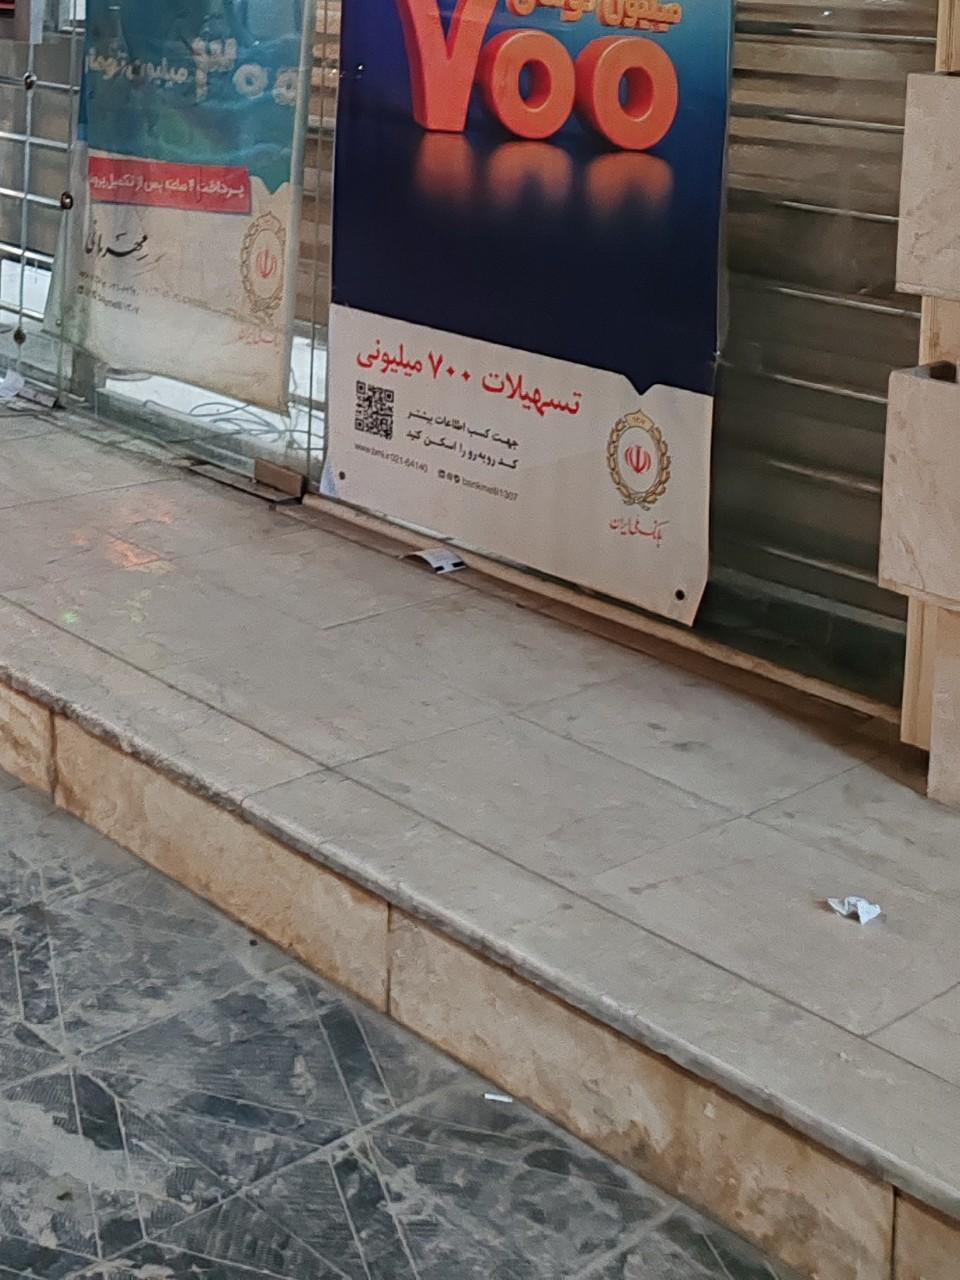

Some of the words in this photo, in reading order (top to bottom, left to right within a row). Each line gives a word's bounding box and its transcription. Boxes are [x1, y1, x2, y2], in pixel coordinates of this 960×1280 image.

[356, 339, 423, 377] میلیونی
[427, 350, 471, 381] ۷۰۰
[481, 372, 582, 416] تسهیلات
[434, 416, 466, 432] اطلاعات
[406, 430, 422, 441] کنید
[467, 427, 491, 438] کسب
[423, 436, 457, 450] اسکن
[491, 433, 519, 450] جهت
[498, 458, 519, 470] کد
